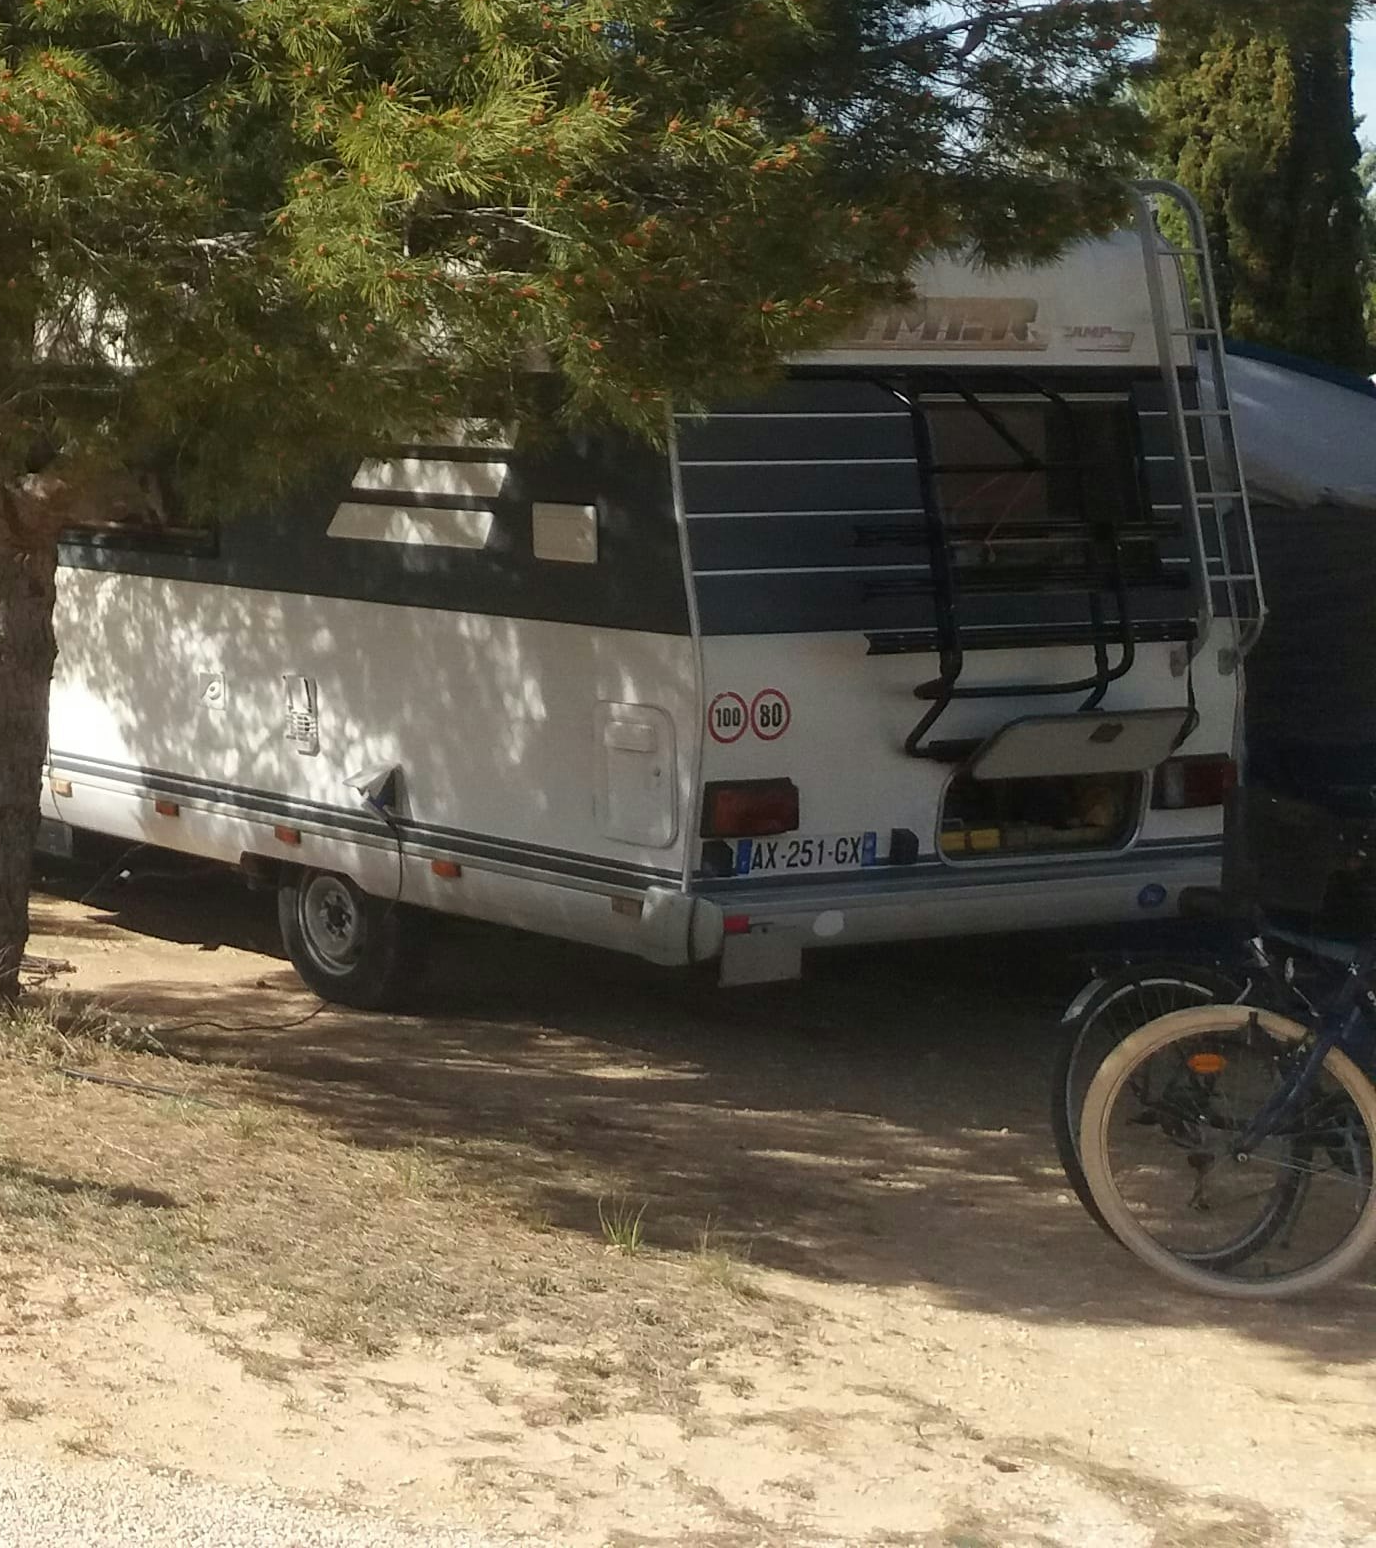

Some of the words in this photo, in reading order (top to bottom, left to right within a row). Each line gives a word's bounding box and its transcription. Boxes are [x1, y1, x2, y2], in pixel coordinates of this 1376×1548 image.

[715, 707, 741, 728] 100
[759, 702, 783, 728] 80
[751, 836, 862, 870] AX-251-GX
